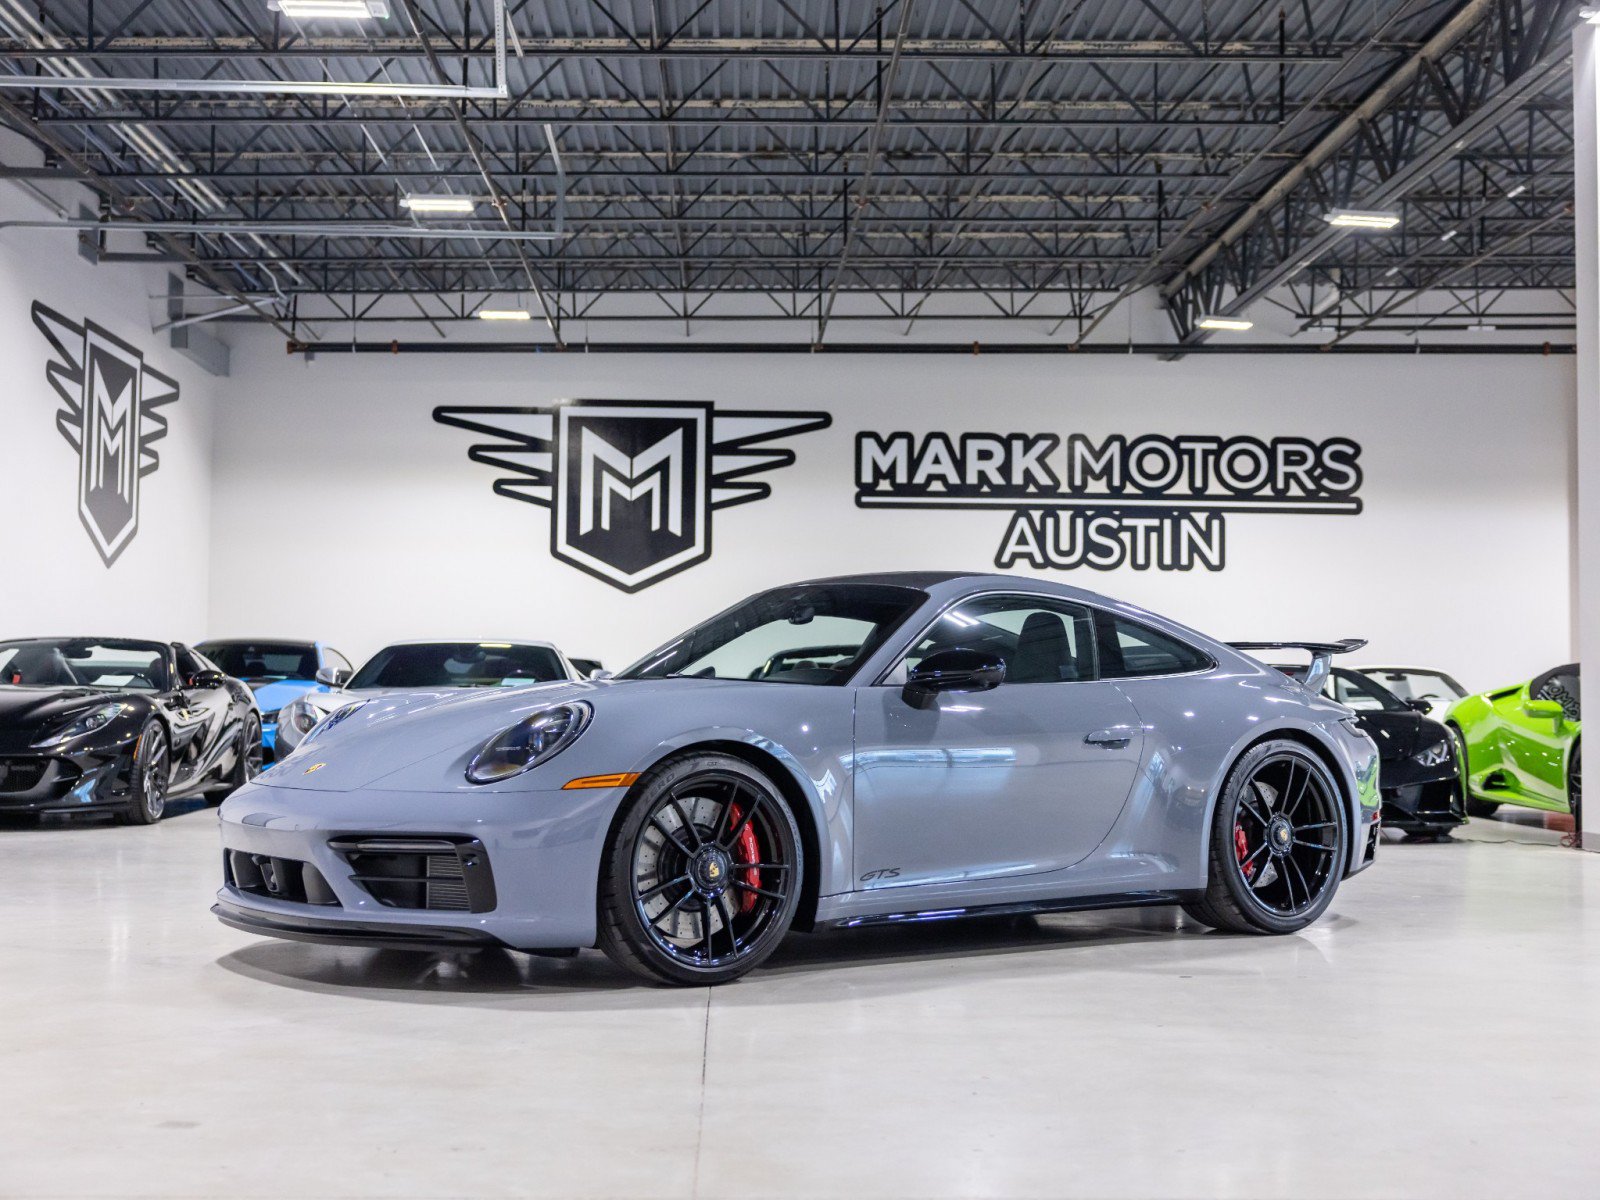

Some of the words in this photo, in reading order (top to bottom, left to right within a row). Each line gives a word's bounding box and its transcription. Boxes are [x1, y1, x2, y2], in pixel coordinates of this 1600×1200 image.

[858, 434, 1060, 490] MARK
[1071, 437, 1359, 493] MOTORS
[998, 512, 1222, 568] AUSTIN
[859, 867, 901, 882] GTS
